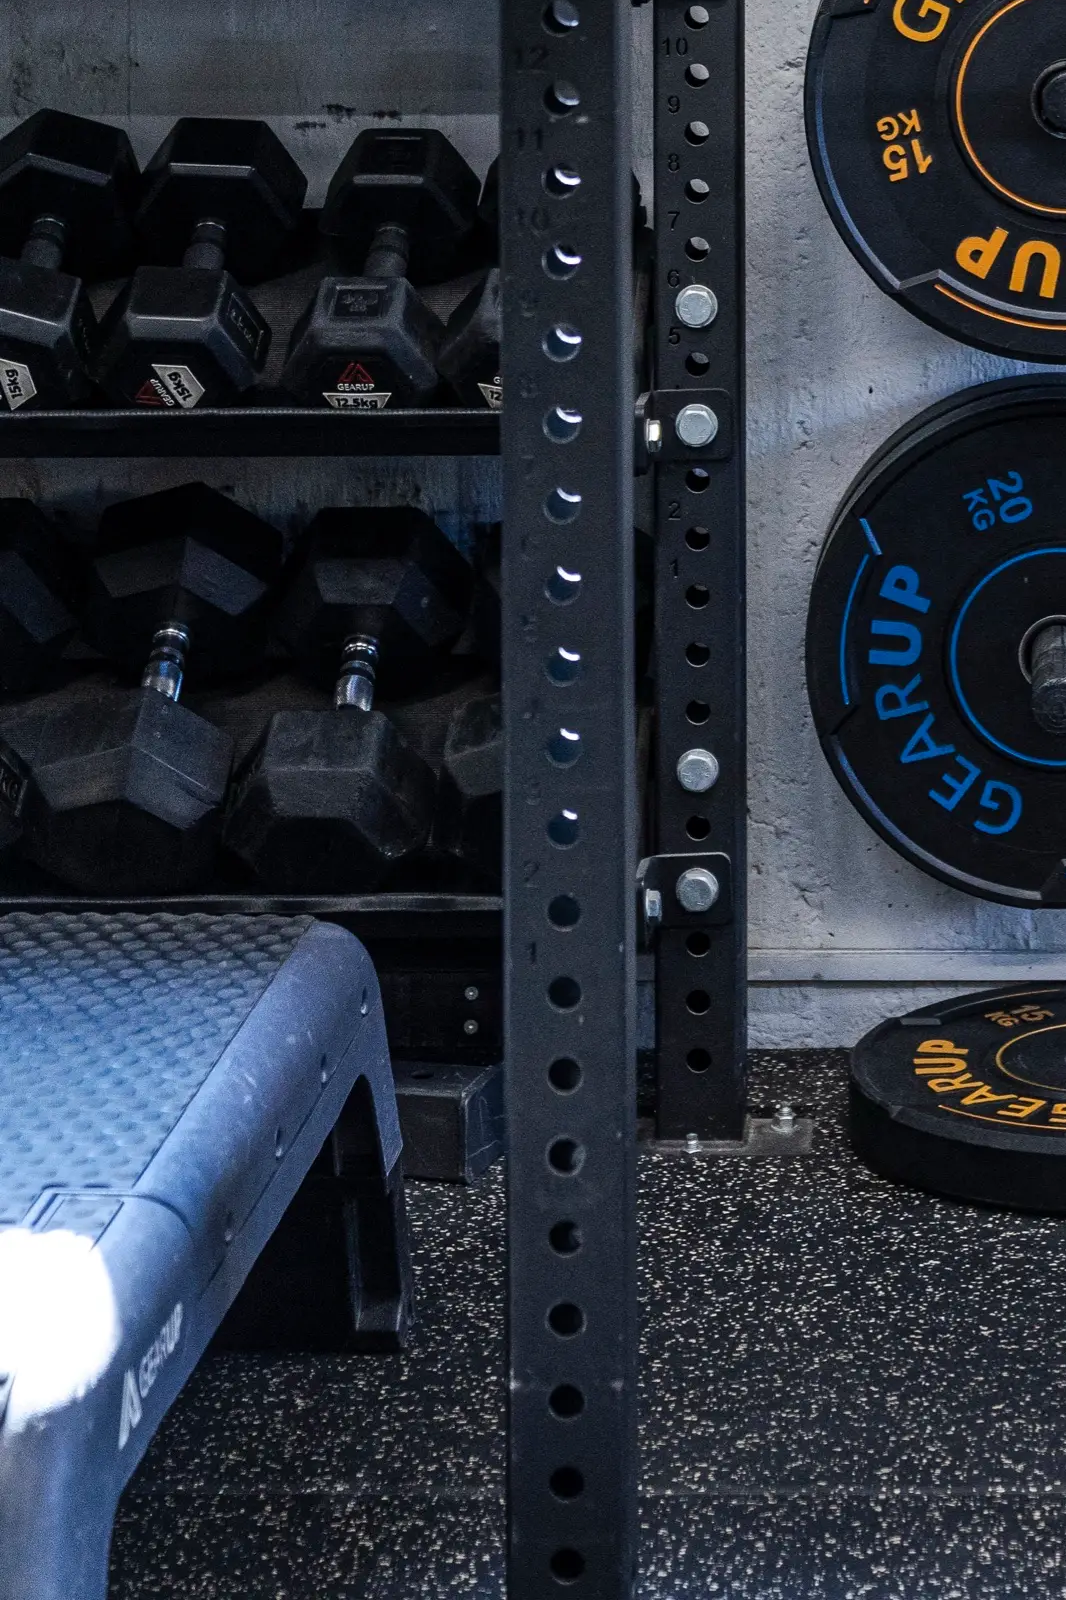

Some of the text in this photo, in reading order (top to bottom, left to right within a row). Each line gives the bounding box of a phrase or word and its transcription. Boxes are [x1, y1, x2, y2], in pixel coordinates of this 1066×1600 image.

[662, 37, 688, 56] 10
[667, 95, 680, 114] 9
[876, 109, 922, 141] KG
[668, 154, 680, 172] 8
[883, 139, 933, 182] 15
[667, 211, 680, 230] 7
[667, 269, 680, 288] 6
[668, 327, 681, 345] 5
[5, 369, 23, 399] 15kg
[150, 379, 175, 406] GEARUP
[167, 371, 193, 401] 15kg
[337, 383, 375, 391] GEARUP
[986, 470, 1034, 525] 20
[668, 502, 681, 520] 2
[962, 488, 996, 532] KG
[669, 559, 679, 578] 1
[868, 564, 1023, 835] GEARUP
[984, 1010, 1019, 1030] KG
[1010, 1004, 1055, 1022] 15
